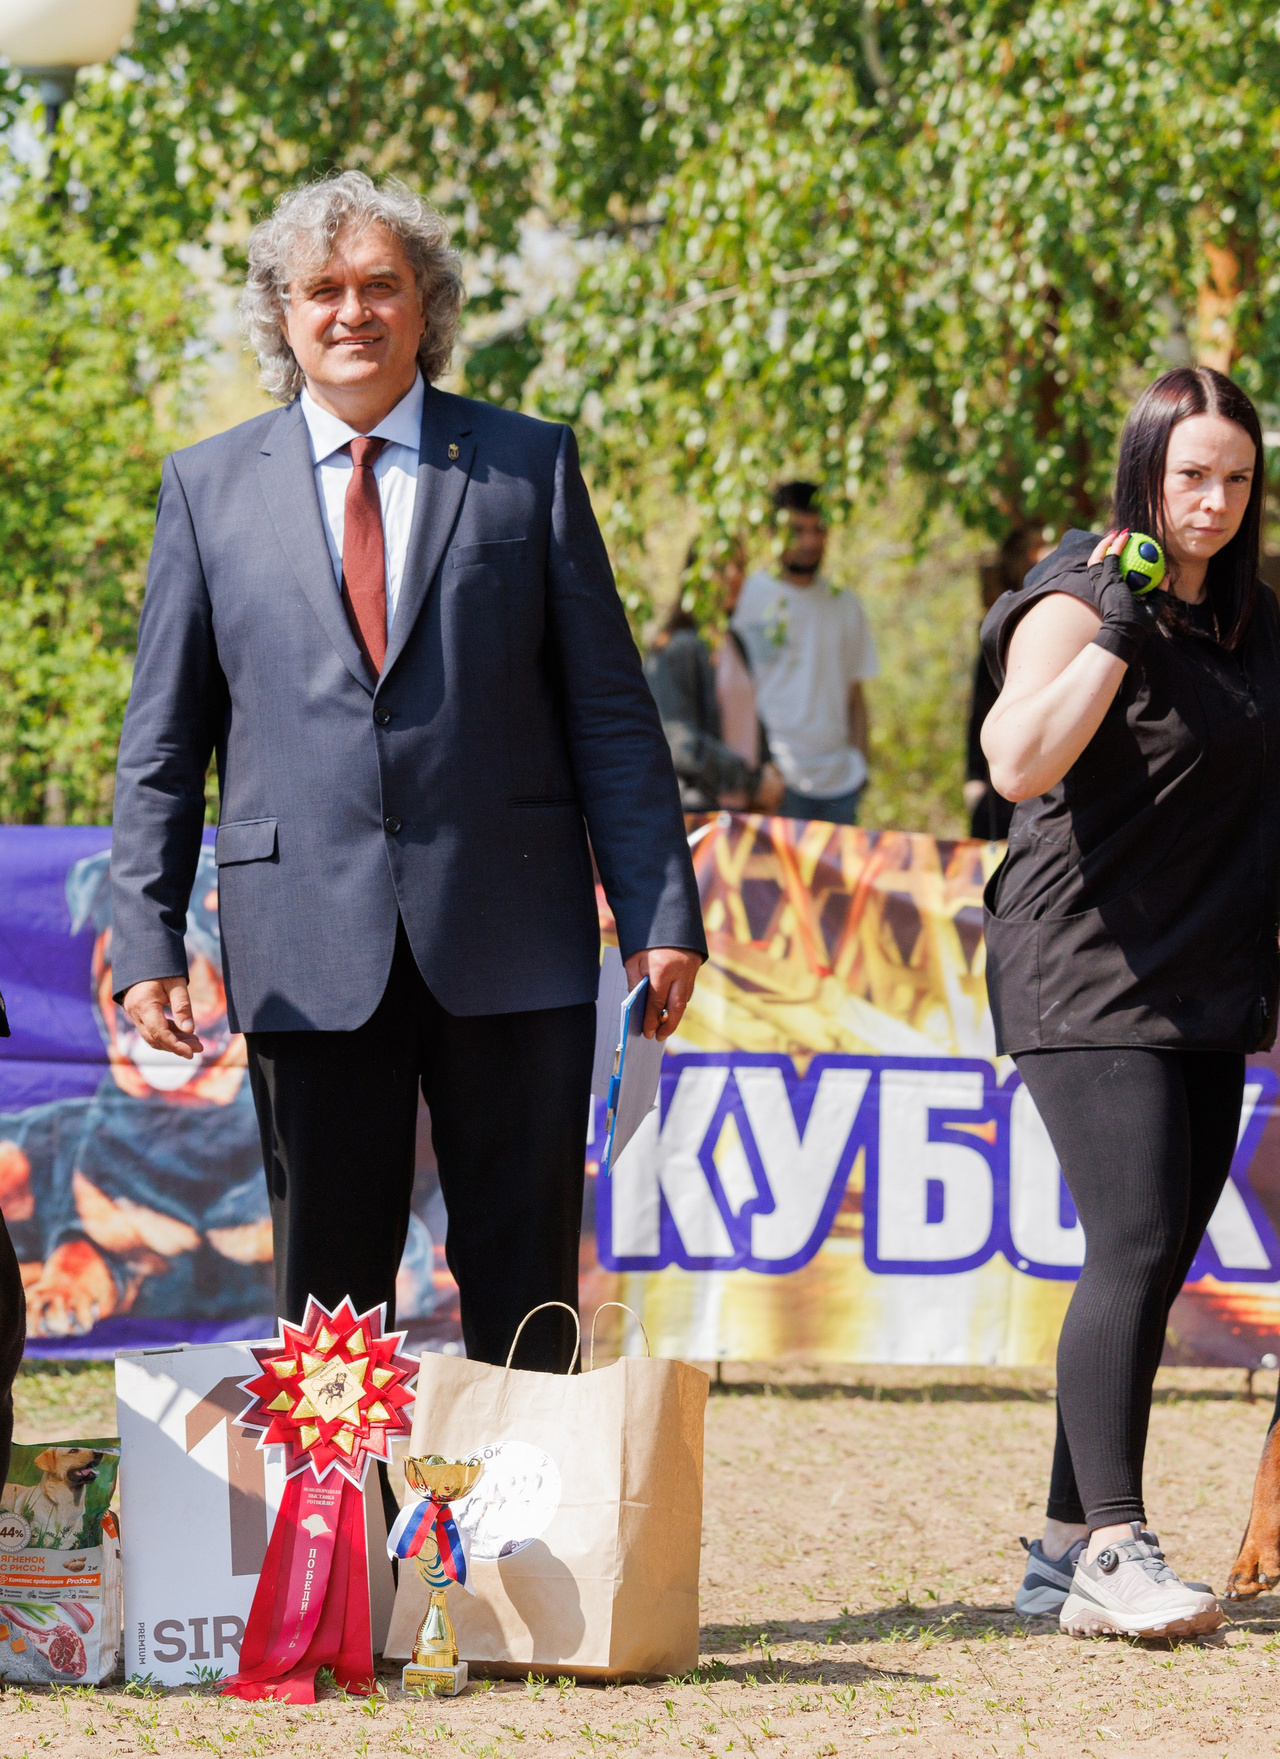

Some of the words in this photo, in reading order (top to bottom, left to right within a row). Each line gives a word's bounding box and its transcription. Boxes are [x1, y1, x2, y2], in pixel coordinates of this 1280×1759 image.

[0, 1527, 24, 1538] 44%
[1, 1554, 45, 1564] ЯГНЕНОК
[0, 1563, 8, 1571] С
[9, 1564, 45, 1572] РИСОМ
[288, 1548, 317, 1648] ПОБЕДИТЕЛЬ
[137, 1622, 146, 1665] PREMIUM
